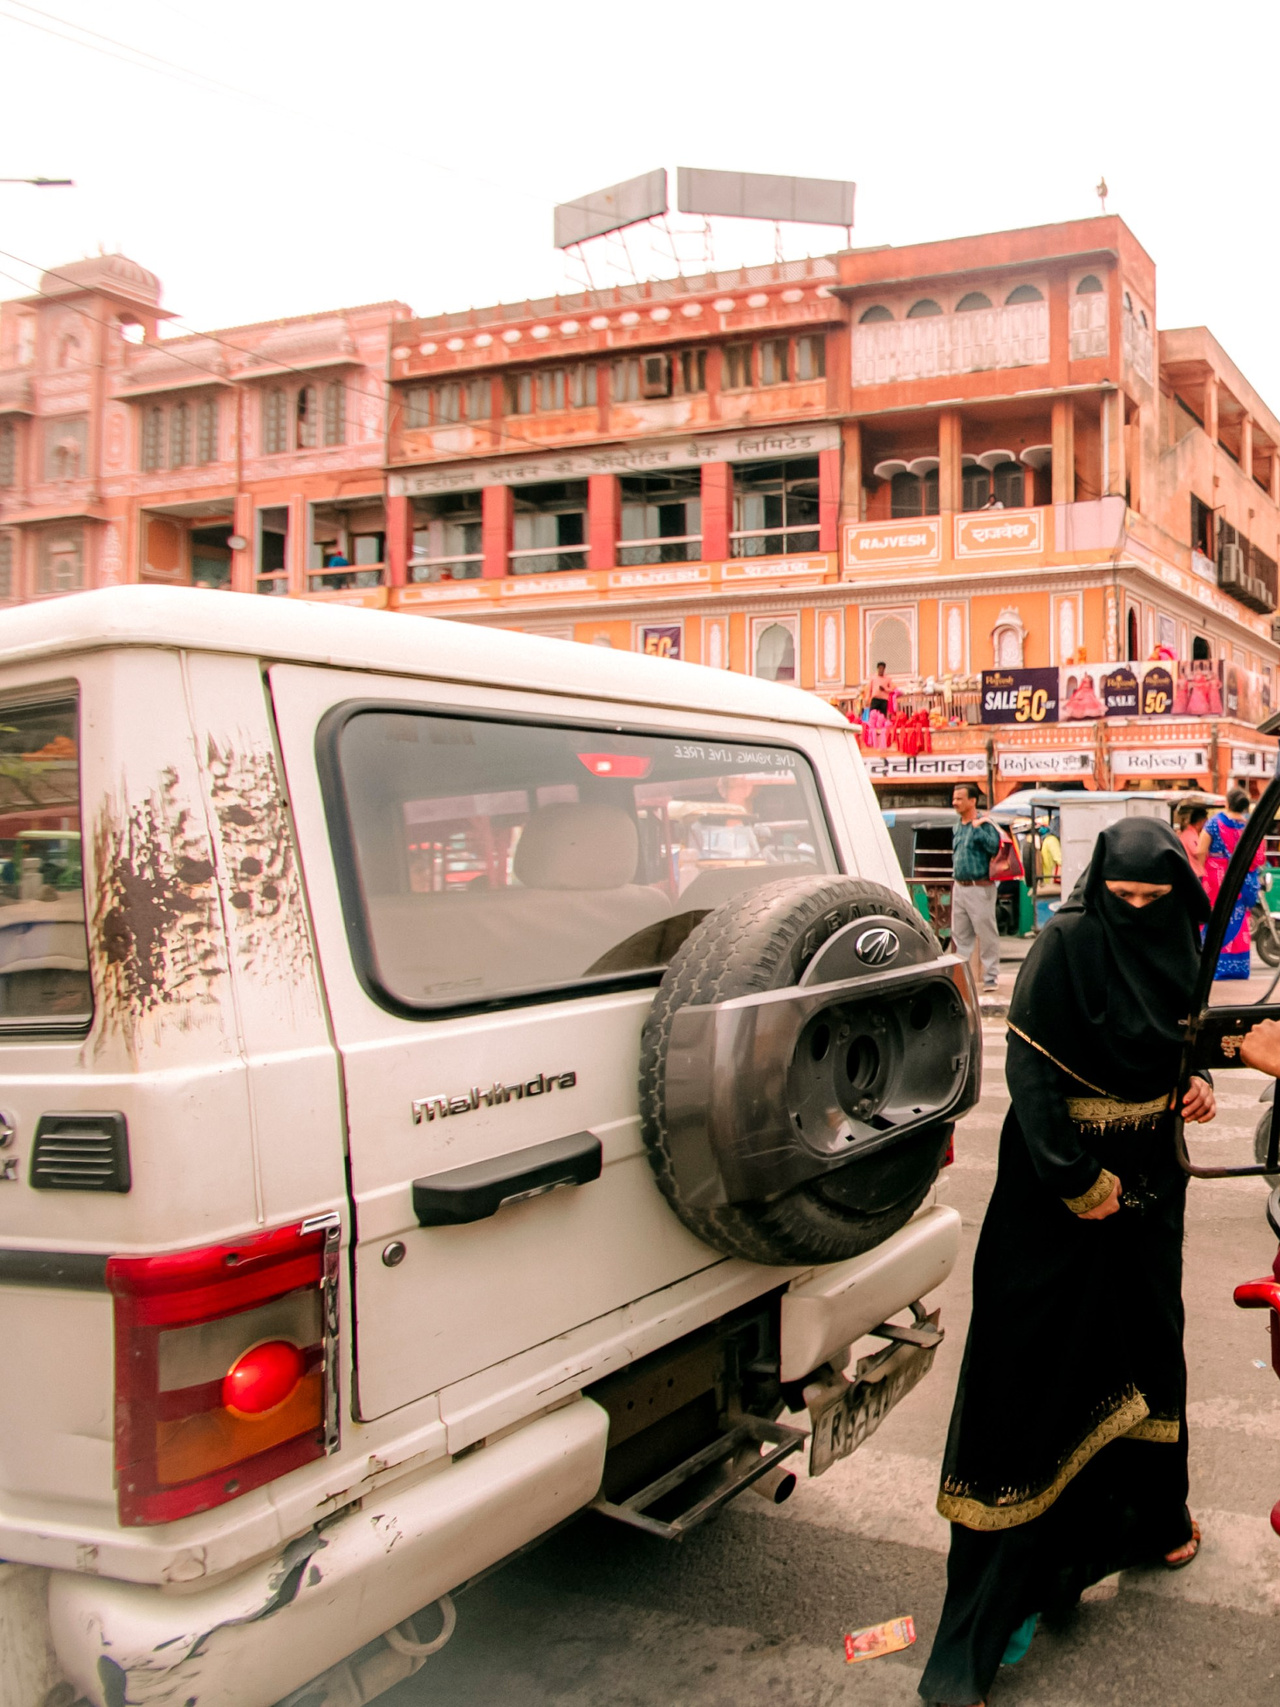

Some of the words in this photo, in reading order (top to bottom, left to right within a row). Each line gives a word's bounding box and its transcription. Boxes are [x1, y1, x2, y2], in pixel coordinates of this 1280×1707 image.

[859, 533, 927, 550] RAJVESH
[984, 690, 1018, 710] SALE
[1015, 689, 1048, 722] 50
[1003, 757, 1060, 772] Rajvesh
[1128, 754, 1188, 769] Rajvesh
